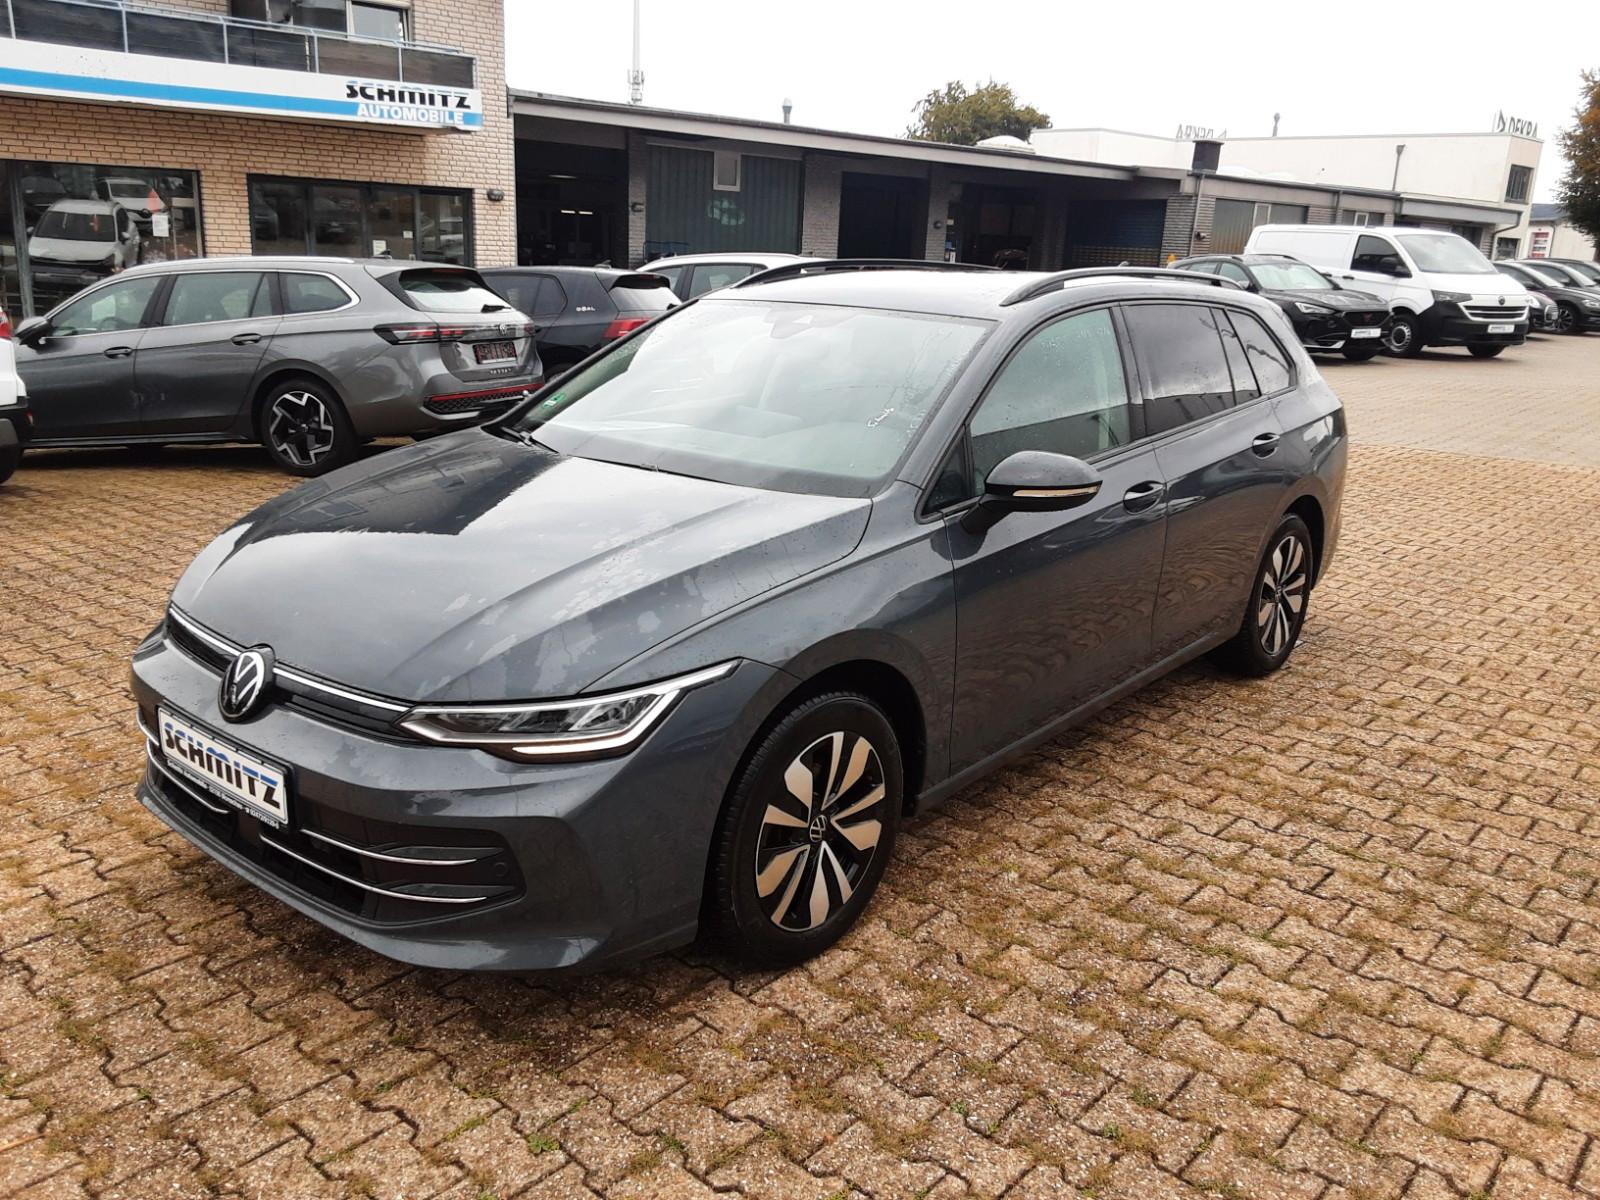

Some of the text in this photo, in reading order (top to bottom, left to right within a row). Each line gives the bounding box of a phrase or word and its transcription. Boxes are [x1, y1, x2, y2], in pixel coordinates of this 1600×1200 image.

[346, 80, 471, 109] SCHMITZ
[357, 103, 464, 124] AUTOMOBILE
[164, 722, 280, 809] SCHMITZ
